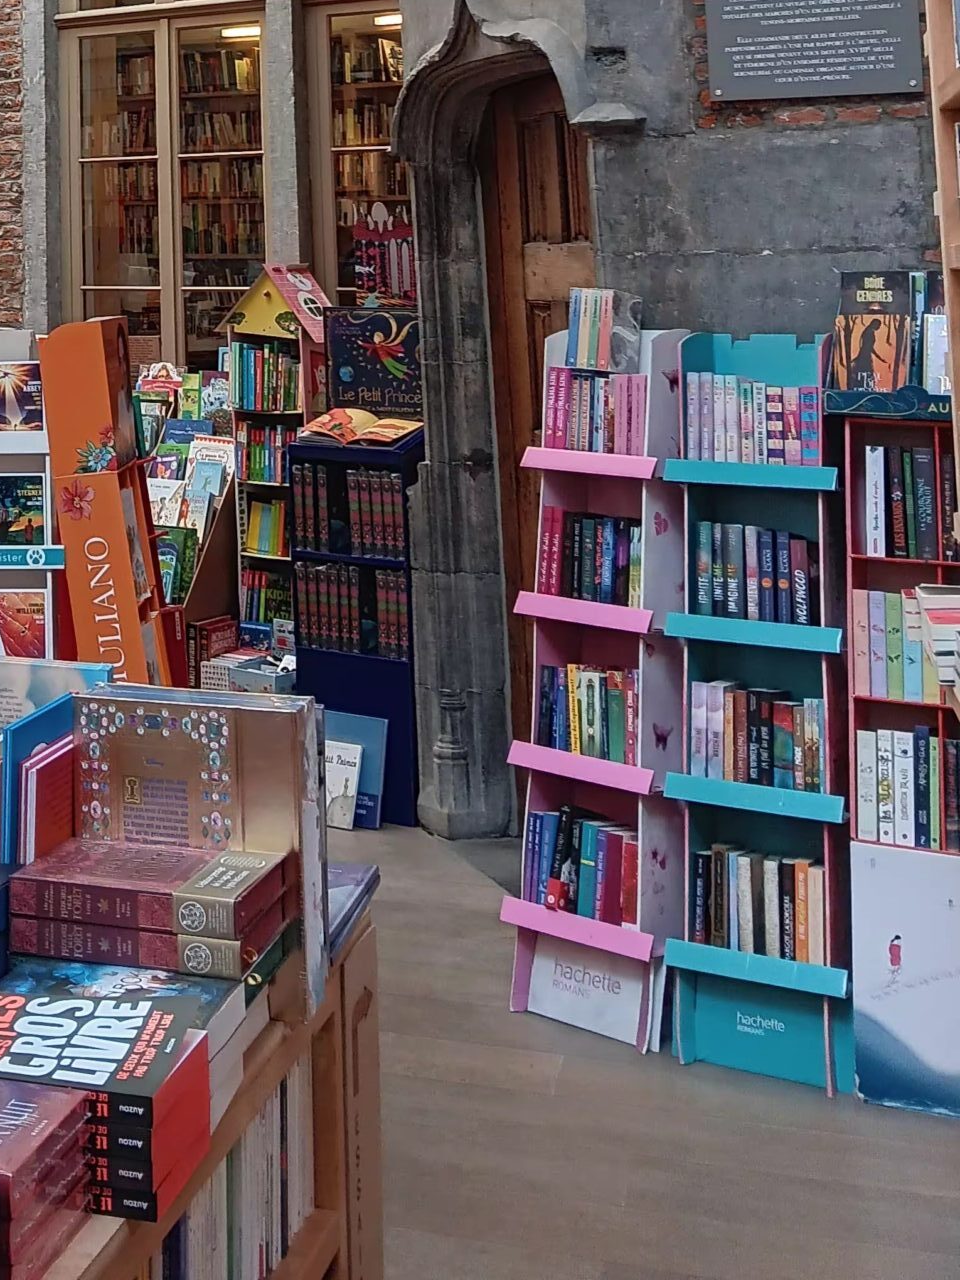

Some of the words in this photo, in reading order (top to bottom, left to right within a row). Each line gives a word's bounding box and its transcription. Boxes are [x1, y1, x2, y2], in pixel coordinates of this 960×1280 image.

[338, 386, 355, 400] Le
[358, 386, 381, 404] Petit
[384, 388, 422, 406] Prince
[917, 478, 926, 522] COURONNE
[713, 563, 722, 577] ME
[698, 576, 709, 604] IGNITE
[713, 577, 724, 600] UNITE
[728, 578, 739, 612] IMAGINE
[794, 570, 808, 624] WOLFWOOD
[337, 754, 358, 768] Prince
[552, 957, 622, 996] hachette
[552, 980, 592, 998] ROMANS
[736, 1012, 785, 1033] hachette
[736, 1024, 765, 1036] ROMANS
[133, 1063, 146, 1078] PAS
[140, 1045, 155, 1066] TROP
[150, 1028, 165, 1047] TROP
[161, 1013, 175, 1028] LIRE
[116, 1068, 130, 1080] DE
[124, 1047, 138, 1069] CEUX
